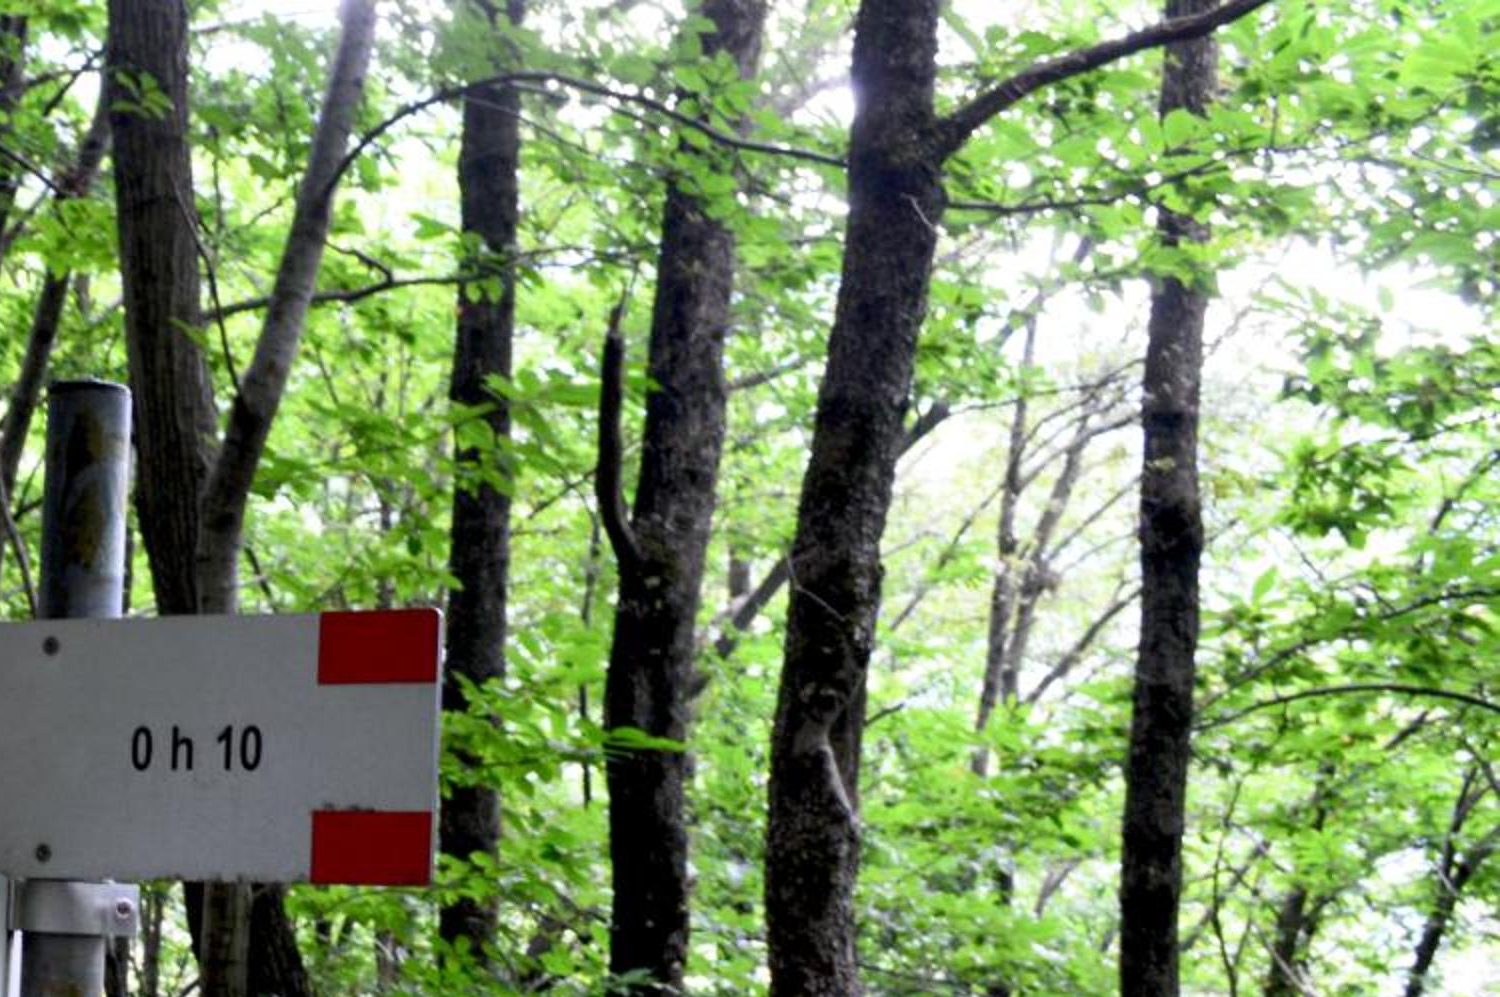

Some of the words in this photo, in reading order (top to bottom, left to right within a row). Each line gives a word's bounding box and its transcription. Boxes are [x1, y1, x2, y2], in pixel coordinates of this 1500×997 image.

[130, 725, 154, 772] 0
[170, 725, 195, 772] h
[216, 725, 264, 772] 10
